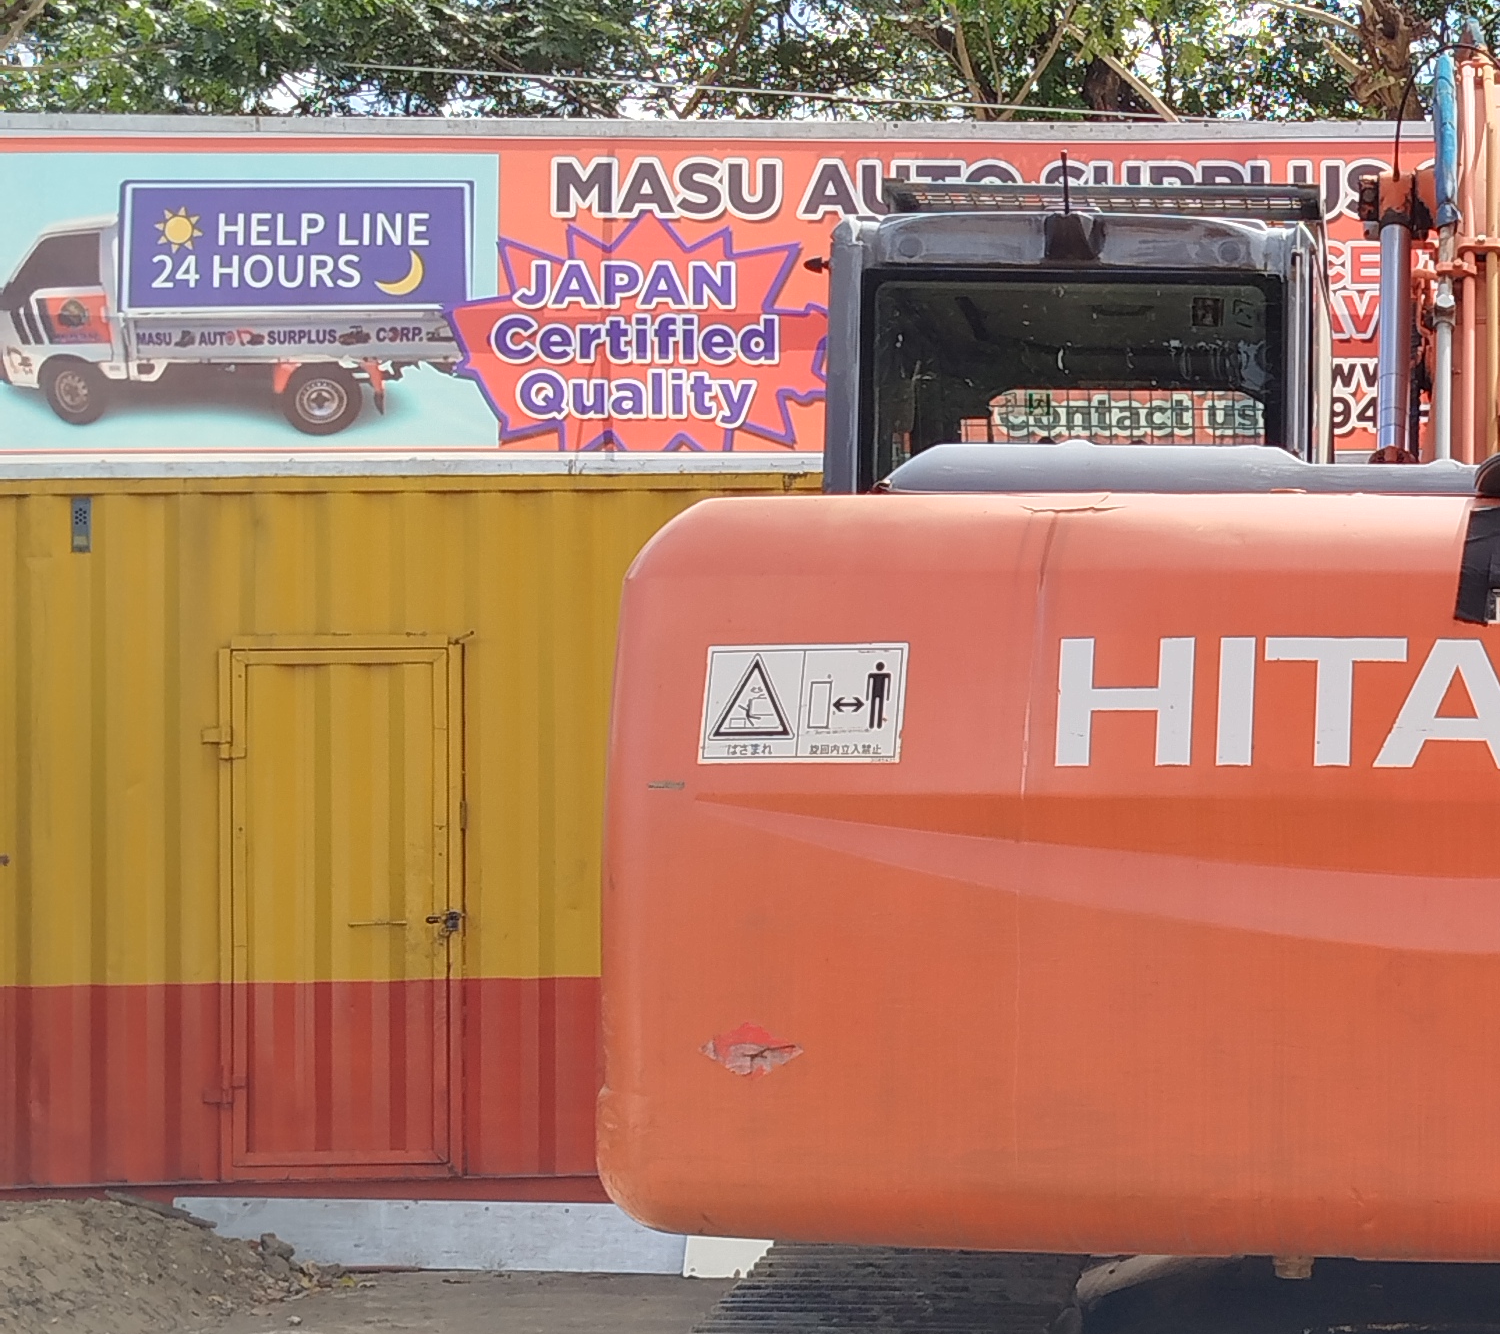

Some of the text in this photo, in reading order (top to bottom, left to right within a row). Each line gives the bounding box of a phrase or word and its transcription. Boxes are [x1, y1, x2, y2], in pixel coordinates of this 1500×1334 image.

[551, 156, 783, 220] MASU
[218, 213, 430, 246] HELP LINE
[151, 254, 361, 289] 24 HOURS
[512, 260, 737, 309] JAPAN
[136, 331, 173, 347] MASU
[266, 328, 337, 346] SURPLUS
[491, 313, 780, 365] Certified
[515, 368, 758, 428] Quality
